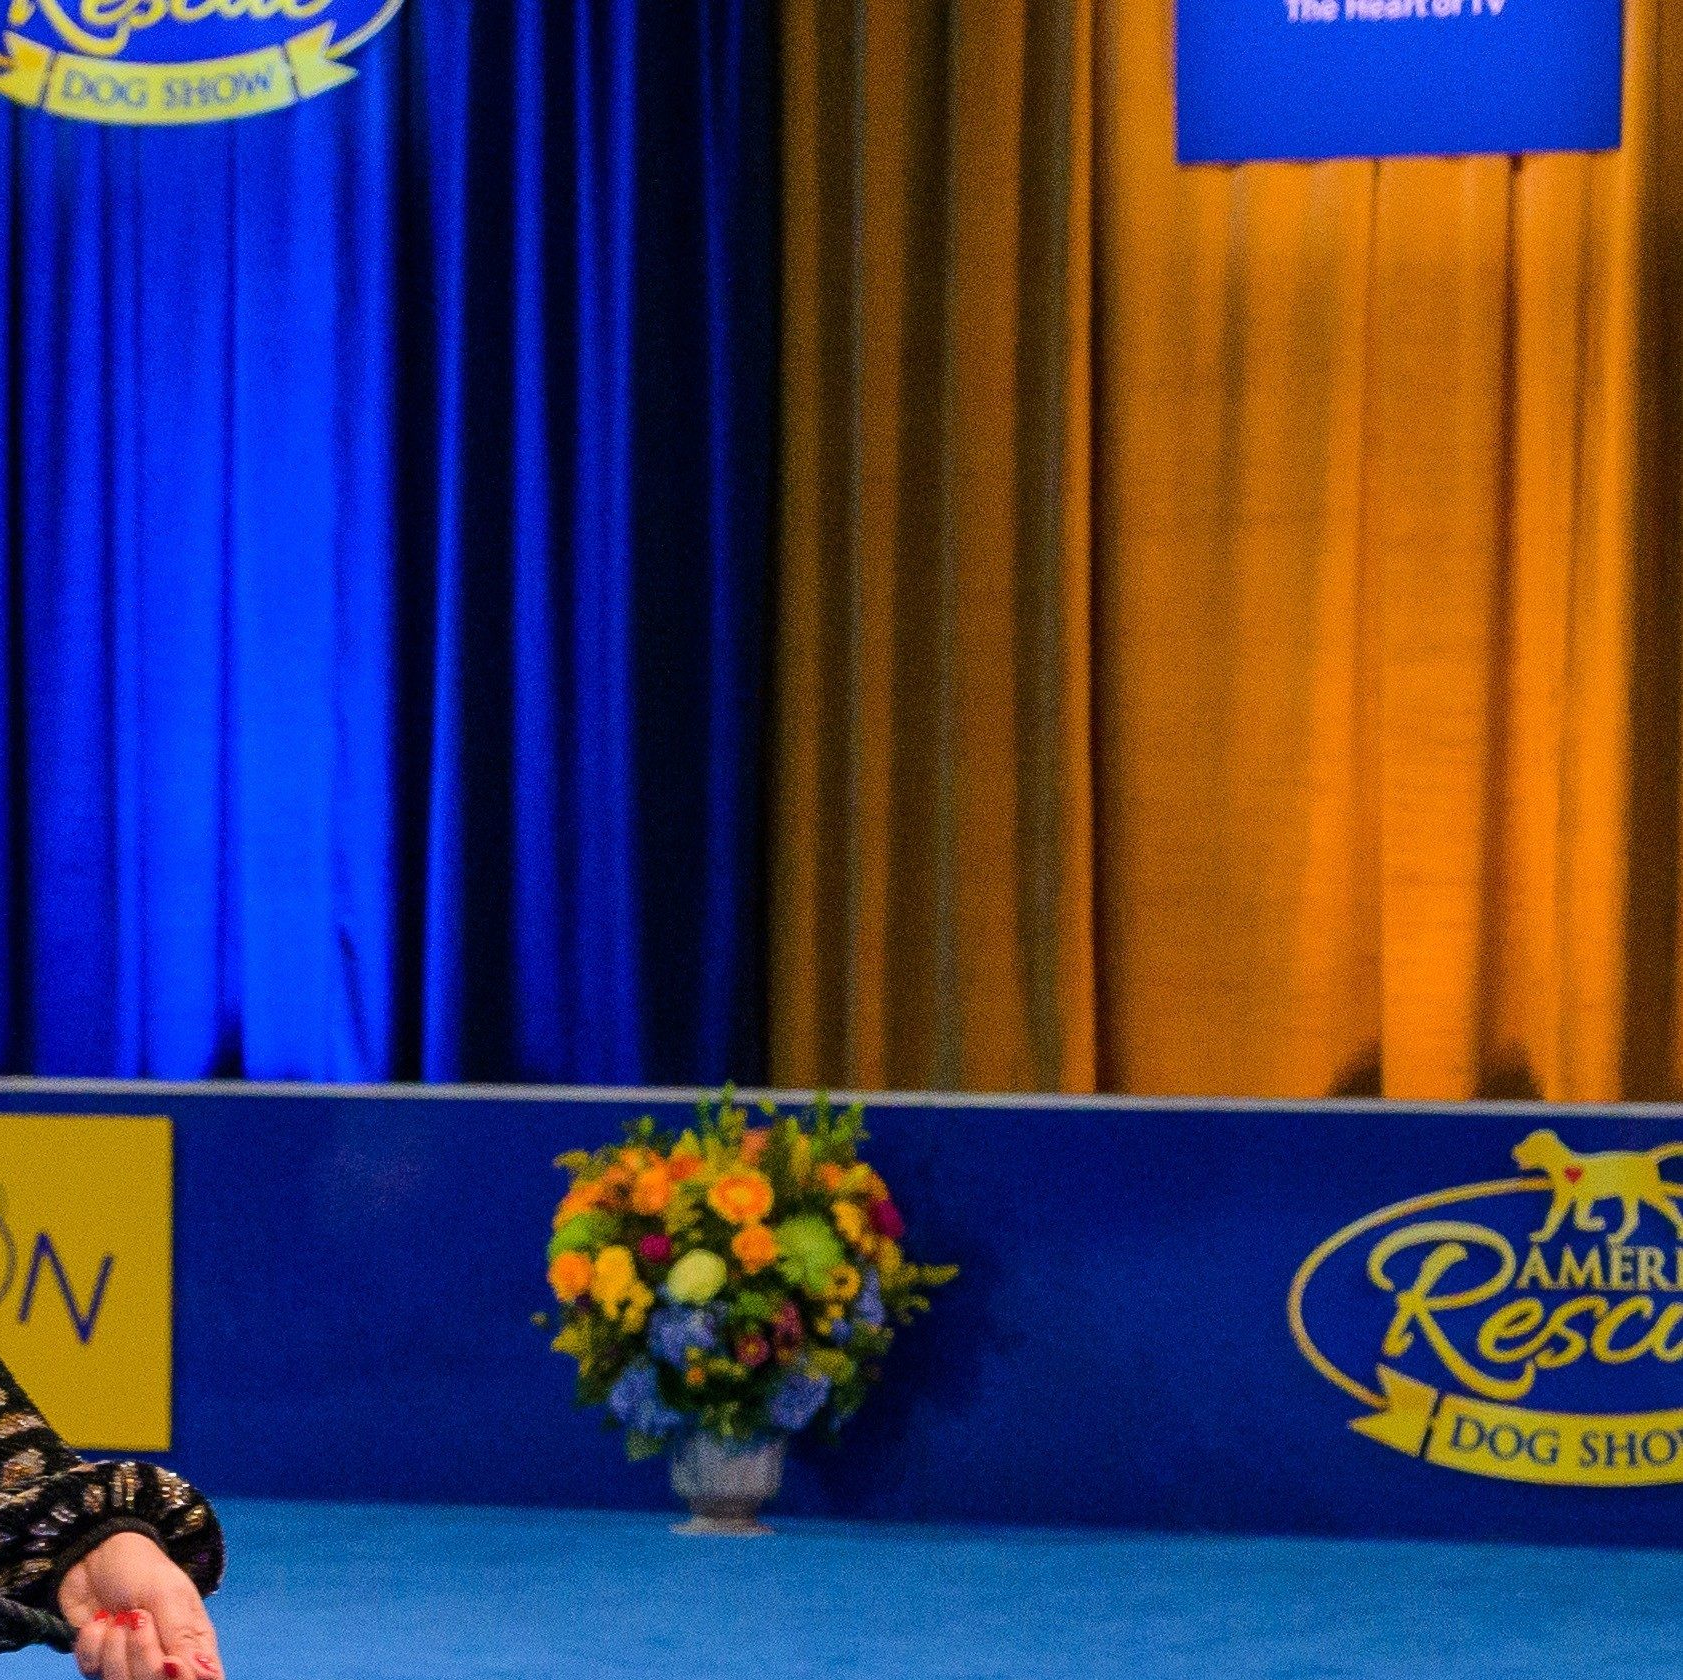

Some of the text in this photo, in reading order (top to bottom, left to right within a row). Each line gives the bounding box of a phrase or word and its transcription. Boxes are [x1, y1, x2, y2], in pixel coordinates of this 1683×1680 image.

[61, 64, 276, 110] DOG SHOW
[1451, 1413, 1683, 1469] DOG SHO
